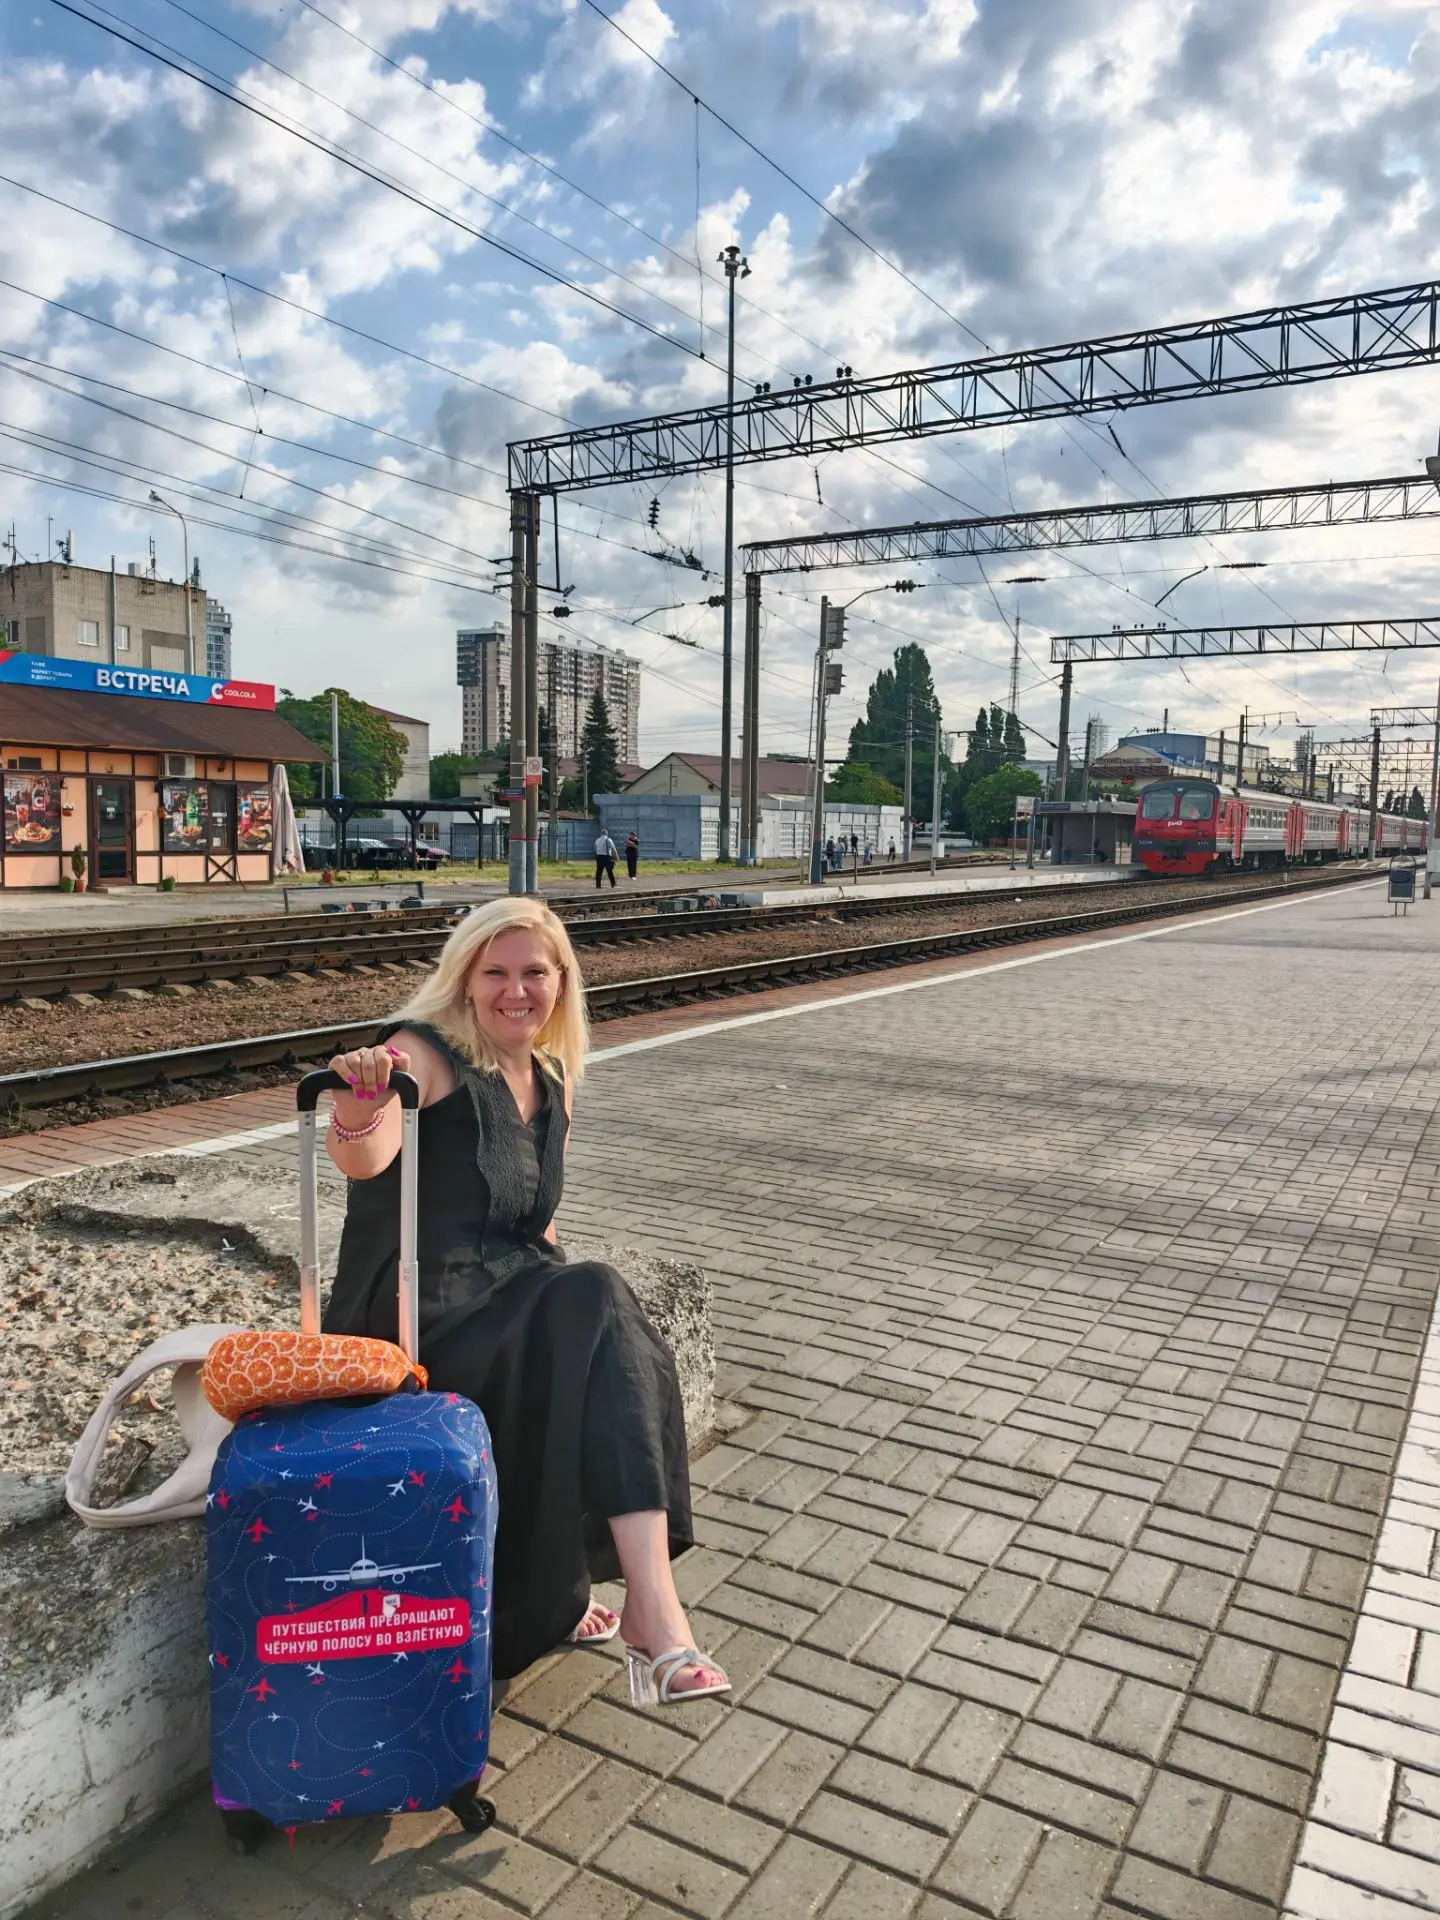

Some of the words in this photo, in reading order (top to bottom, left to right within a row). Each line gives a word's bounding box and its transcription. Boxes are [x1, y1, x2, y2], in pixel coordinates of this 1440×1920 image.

[96, 668, 190, 696] ВСТРЕЧА
[224, 688, 256, 699] COOLCOLA
[272, 1617, 366, 1637] ПУТЕШЕСТВИЯ
[369, 1608, 456, 1628] ПРЕВРАЩАЮТ
[264, 1640, 318, 1655] ЧЁРНУЮ
[322, 1635, 372, 1651] ПОЛОСУ
[376, 1633, 392, 1646] ВО
[396, 1624, 464, 1644] ВЗЛЁТНУЮ
